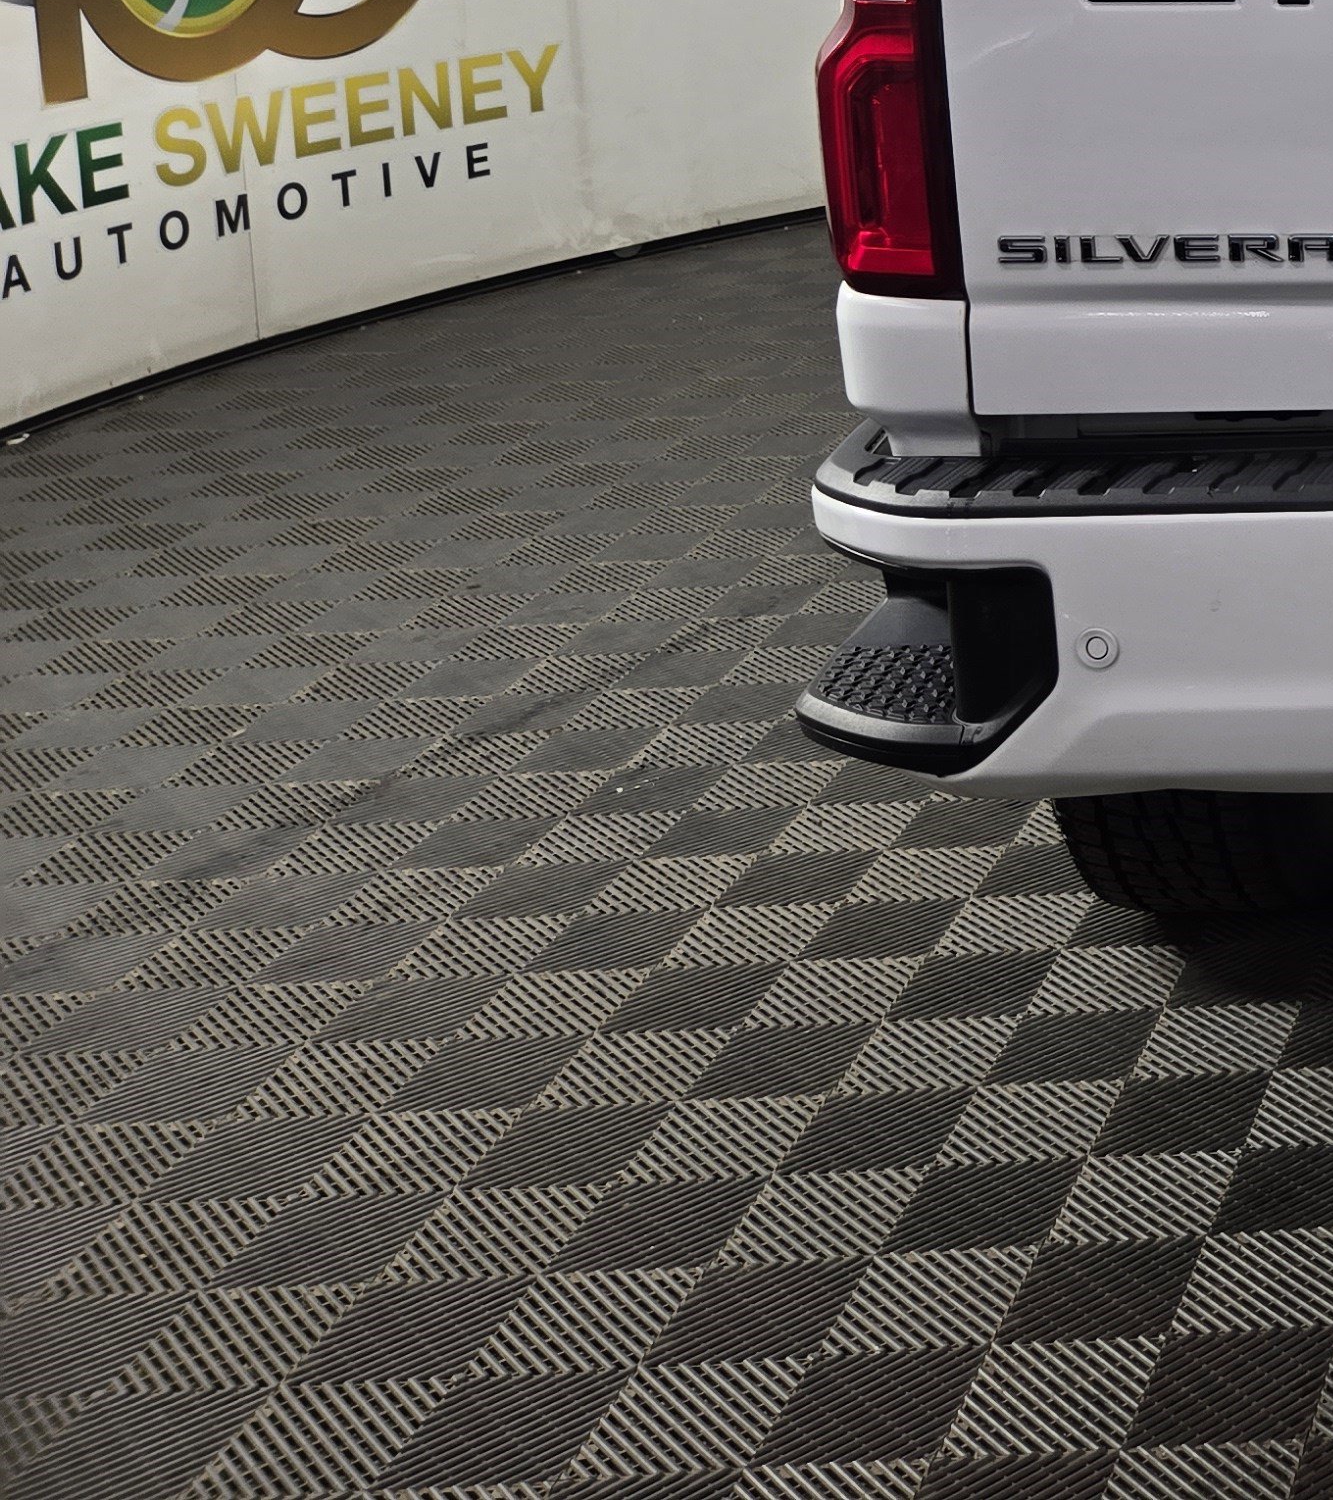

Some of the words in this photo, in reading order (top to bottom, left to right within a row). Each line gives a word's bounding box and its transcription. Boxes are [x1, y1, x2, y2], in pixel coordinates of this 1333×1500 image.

[0, 122, 130, 231] KE
[154, 43, 561, 188] SWEENEY
[2, 142, 491, 299] AUTOMOTIVE
